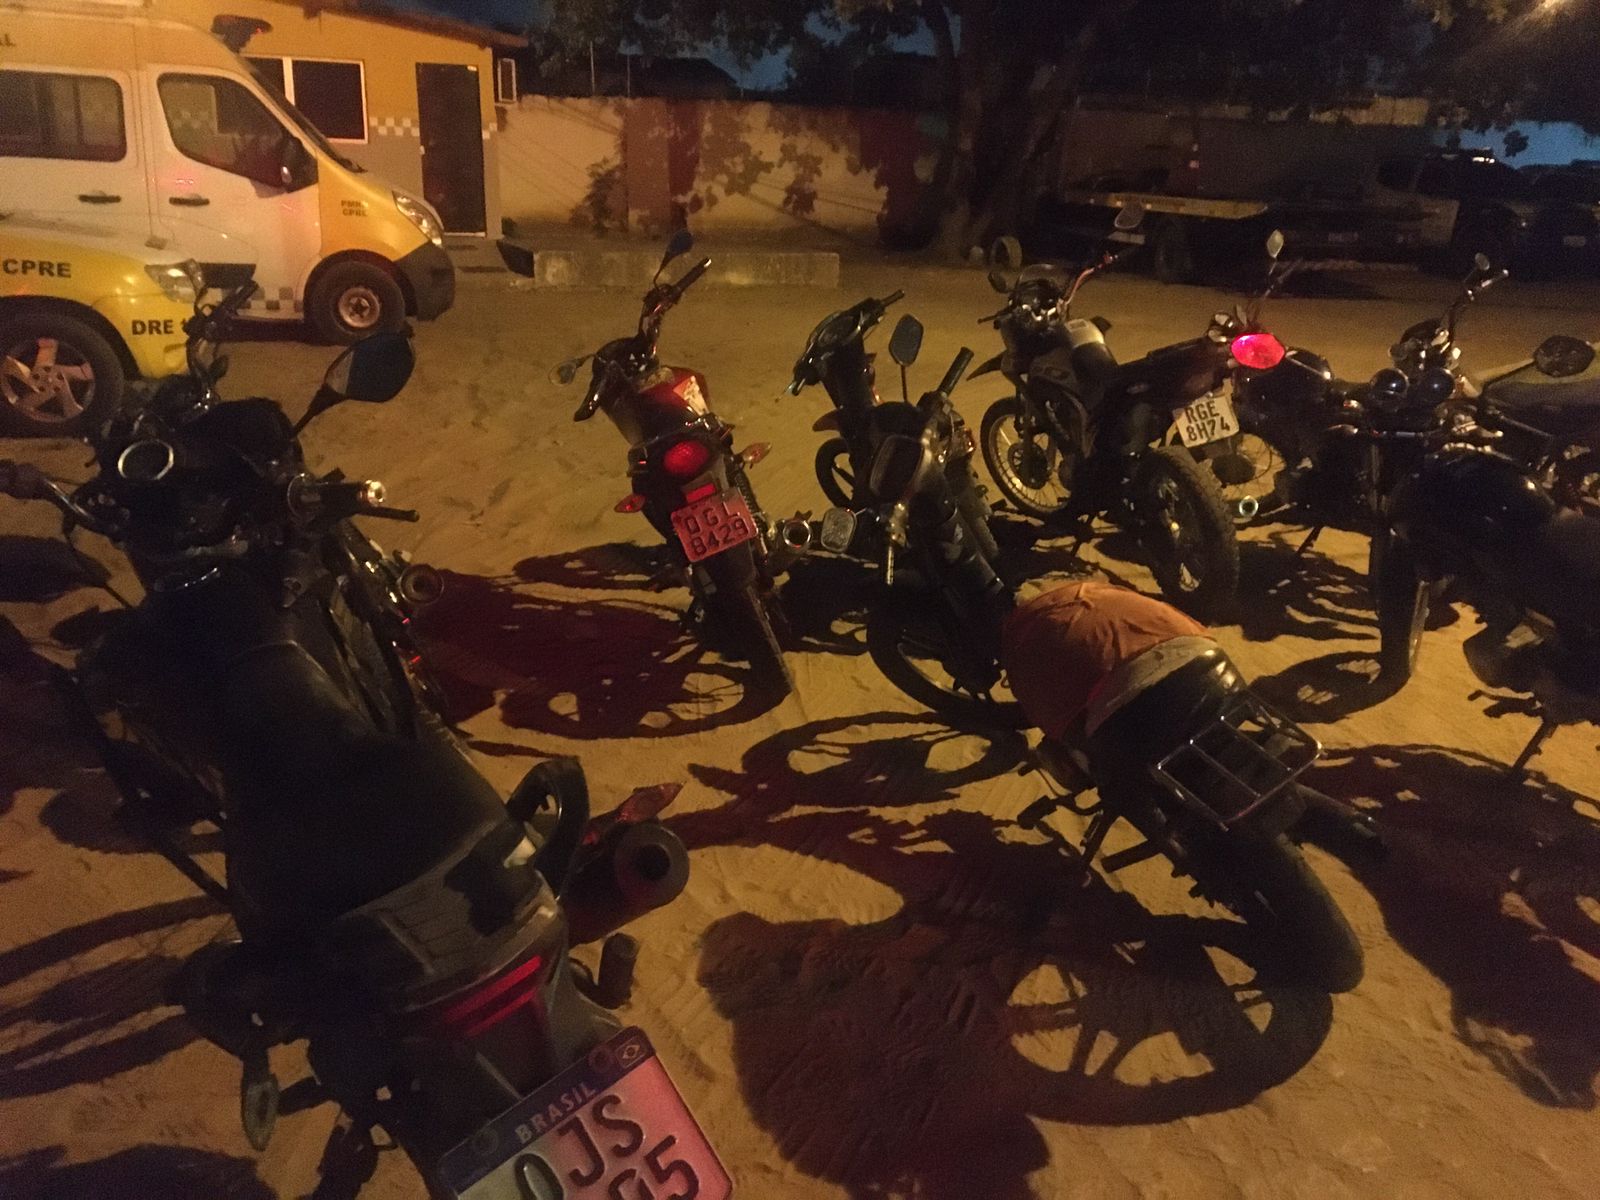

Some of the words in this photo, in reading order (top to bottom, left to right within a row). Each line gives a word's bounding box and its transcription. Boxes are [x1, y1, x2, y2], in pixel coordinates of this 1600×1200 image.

[3, 259, 72, 279] CPRE
[131, 319, 174, 336] DRE
[1184, 400, 1220, 424] RGE
[1186, 416, 1231, 441] 8H74
[515, 1081, 597, 1144] BRASIL
[514, 1094, 645, 1200] OJS
